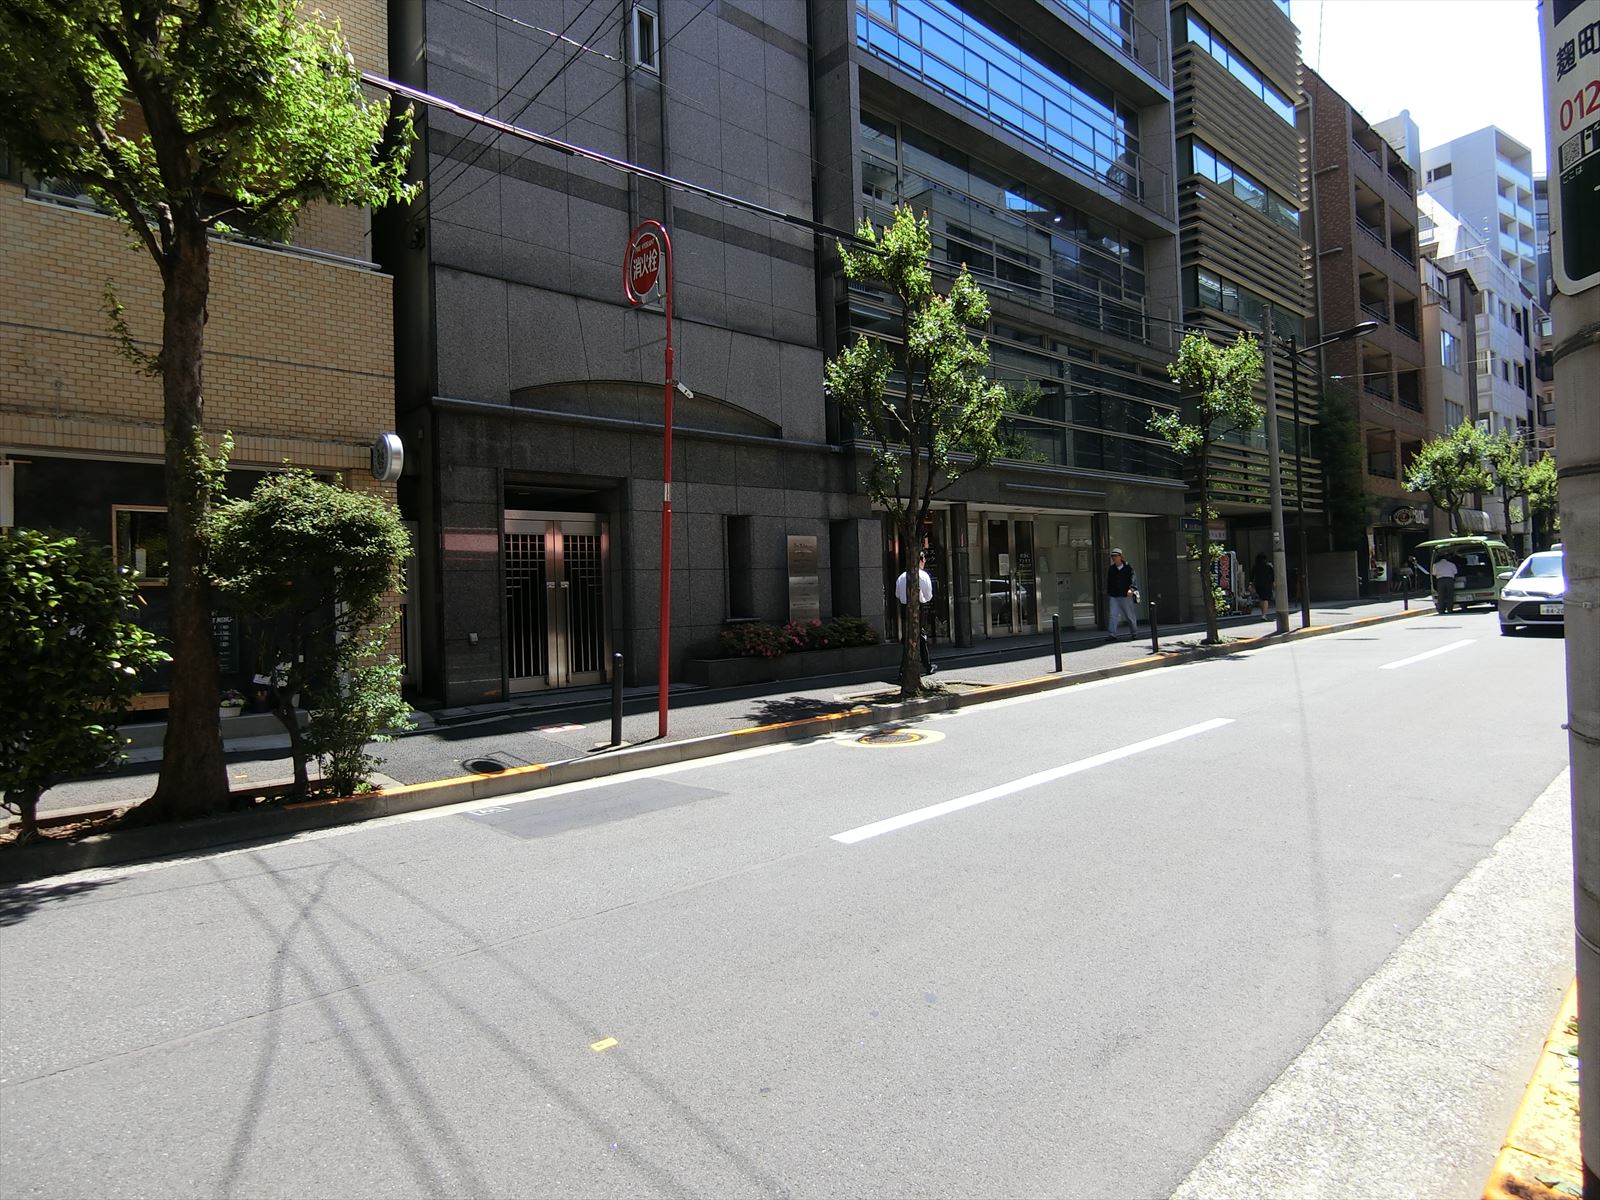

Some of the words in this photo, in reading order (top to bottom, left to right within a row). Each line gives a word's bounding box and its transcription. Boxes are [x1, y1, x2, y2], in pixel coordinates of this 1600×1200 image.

[1559, 79, 1600, 132] 012
[1562, 165, 1584, 184] ここは
[633, 248, 658, 280] 消火栓
